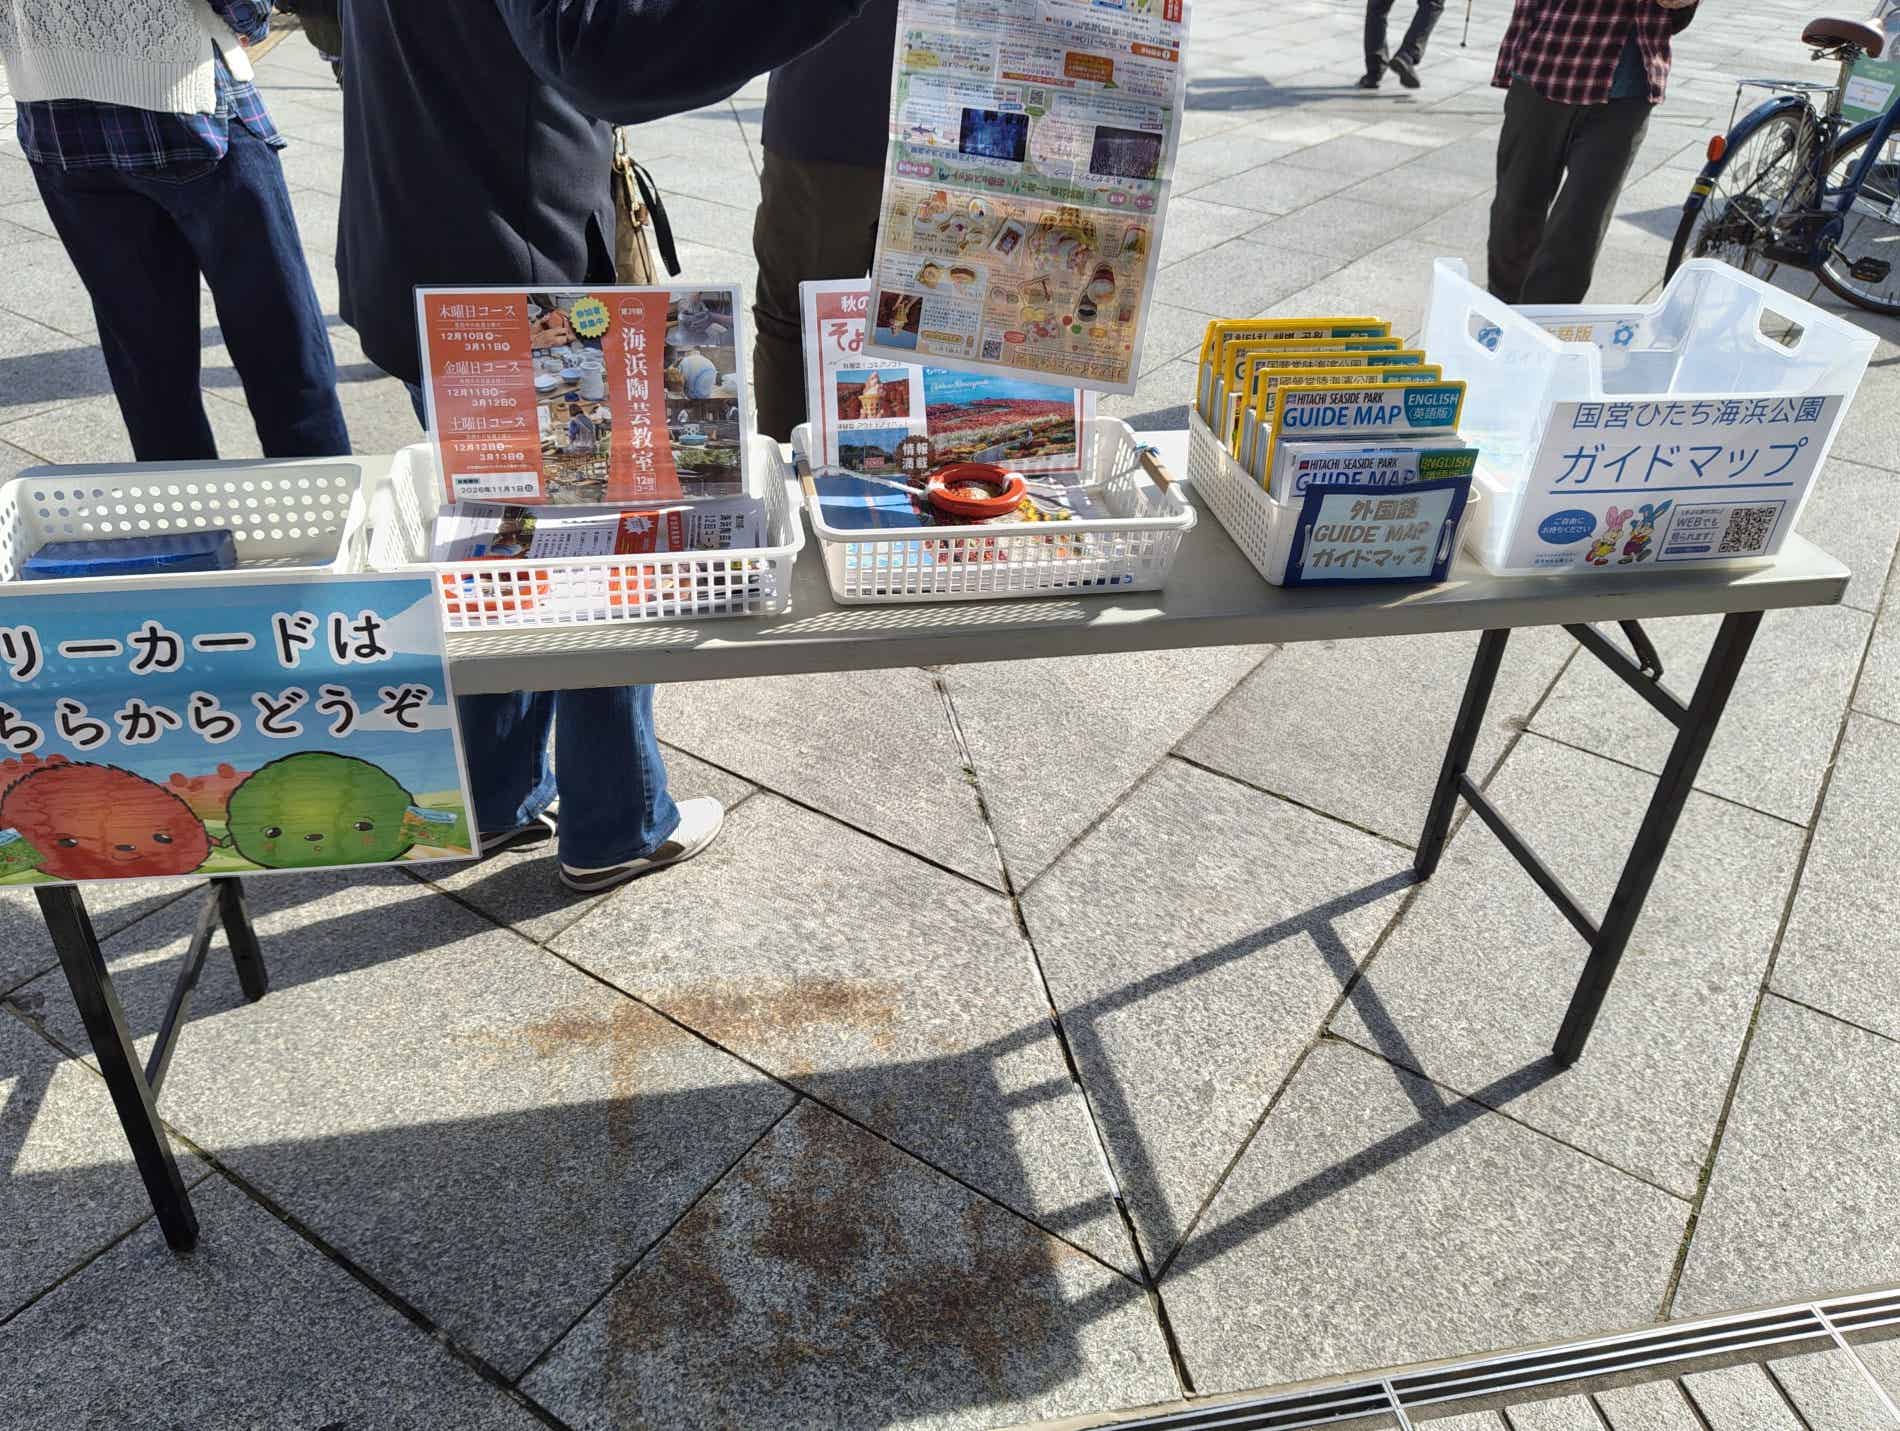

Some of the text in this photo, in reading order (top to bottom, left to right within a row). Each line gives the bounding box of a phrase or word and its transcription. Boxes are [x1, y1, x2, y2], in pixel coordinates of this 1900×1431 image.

[439, 304, 516, 319] 木曜日コース
[443, 360, 521, 375] 金曜日コース
[622, 327, 656, 472] 海浜陶芸教室
[1297, 391, 1385, 405] HITACHI SEASIDE PARK
[1408, 393, 1459, 406] ENGLISH
[1282, 405, 1402, 427] GUIDE MAP
[1572, 396, 1826, 431] 国営ひたち海浜公園
[1309, 457, 1399, 470] HITACHI SEASIDE PARK
[1554, 437, 1808, 485] ガイドマップ
[1296, 471, 1362, 492] GUIDE
[1367, 469, 1417, 485] MAP
[1350, 496, 1420, 521] 外国語
[1312, 521, 1430, 543] GUIDE MAP
[1312, 545, 1428, 569] ガイドマップ
[2, 614, 386, 678] リーカードは
[0, 688, 430, 748] ちらからどうぞ
